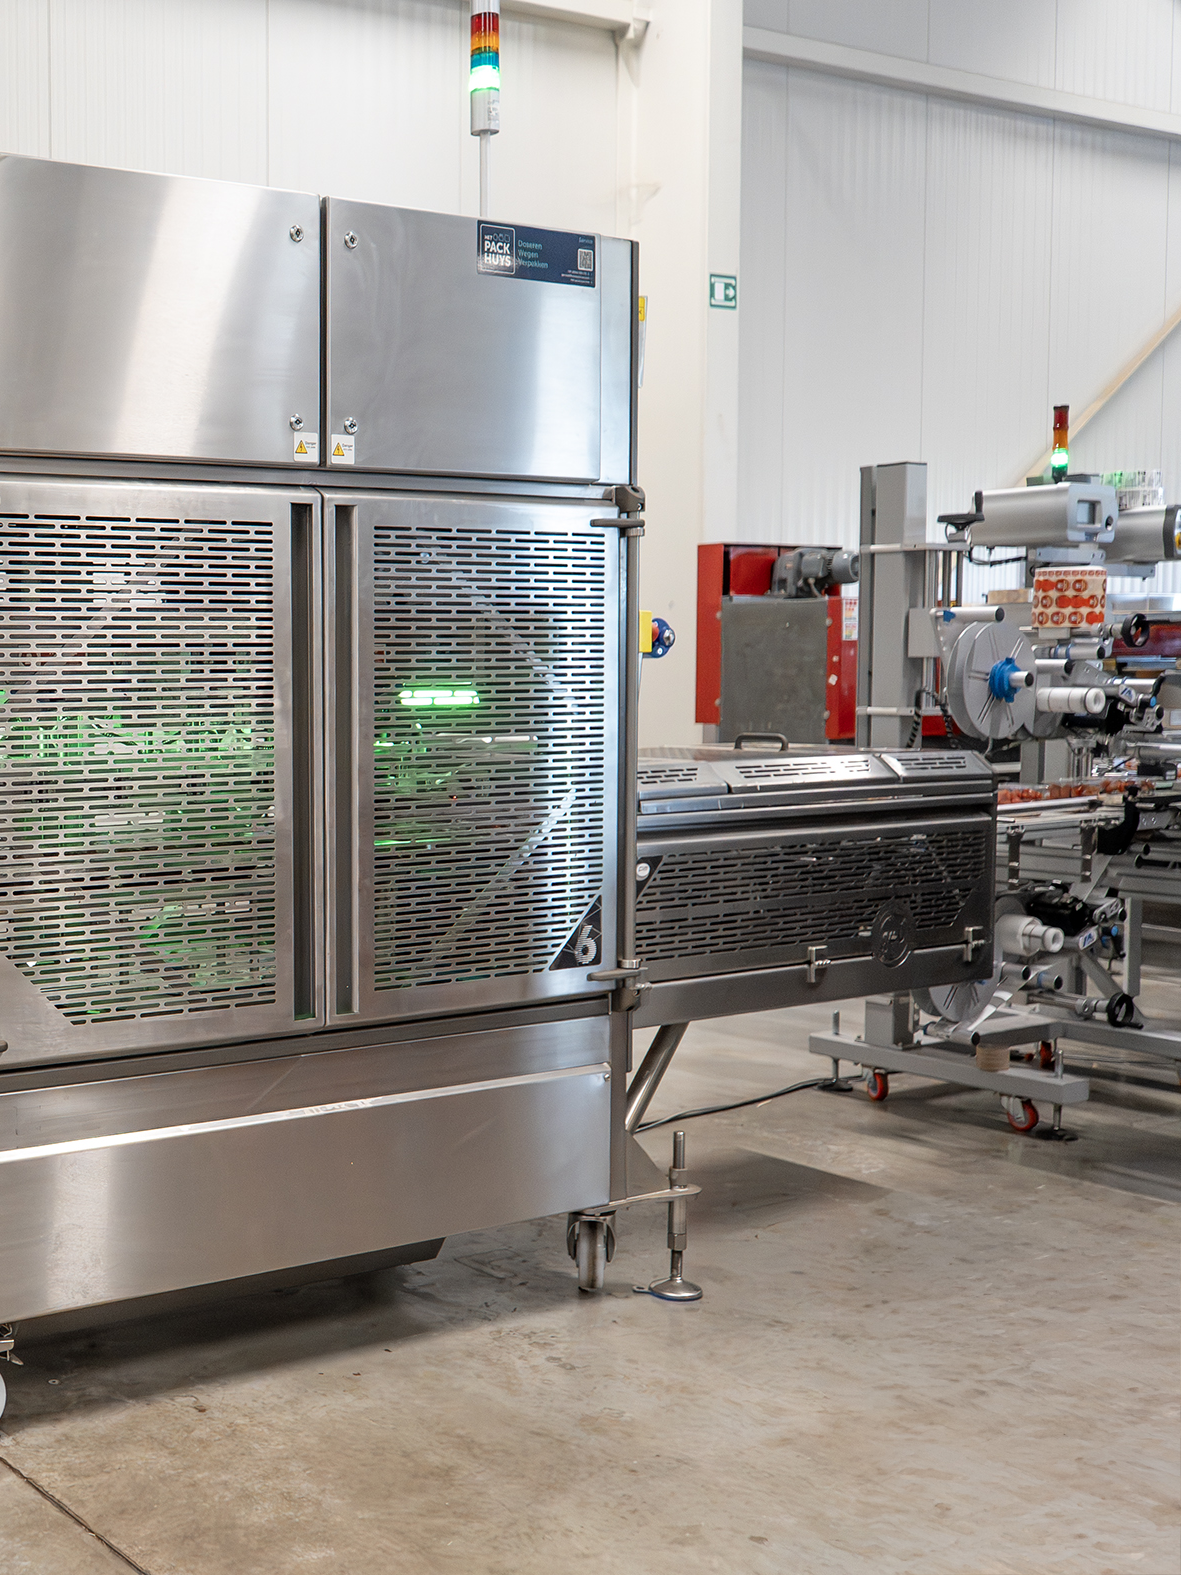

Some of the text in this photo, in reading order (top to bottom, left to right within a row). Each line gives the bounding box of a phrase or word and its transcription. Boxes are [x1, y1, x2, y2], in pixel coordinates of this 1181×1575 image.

[484, 241, 511, 254] PACK
[518, 239, 542, 250] Doseren
[484, 252, 511, 267] HUYS
[518, 249, 539, 258] Wegen
[518, 258, 549, 269] Verpakken
[574, 925, 597, 965] 6
